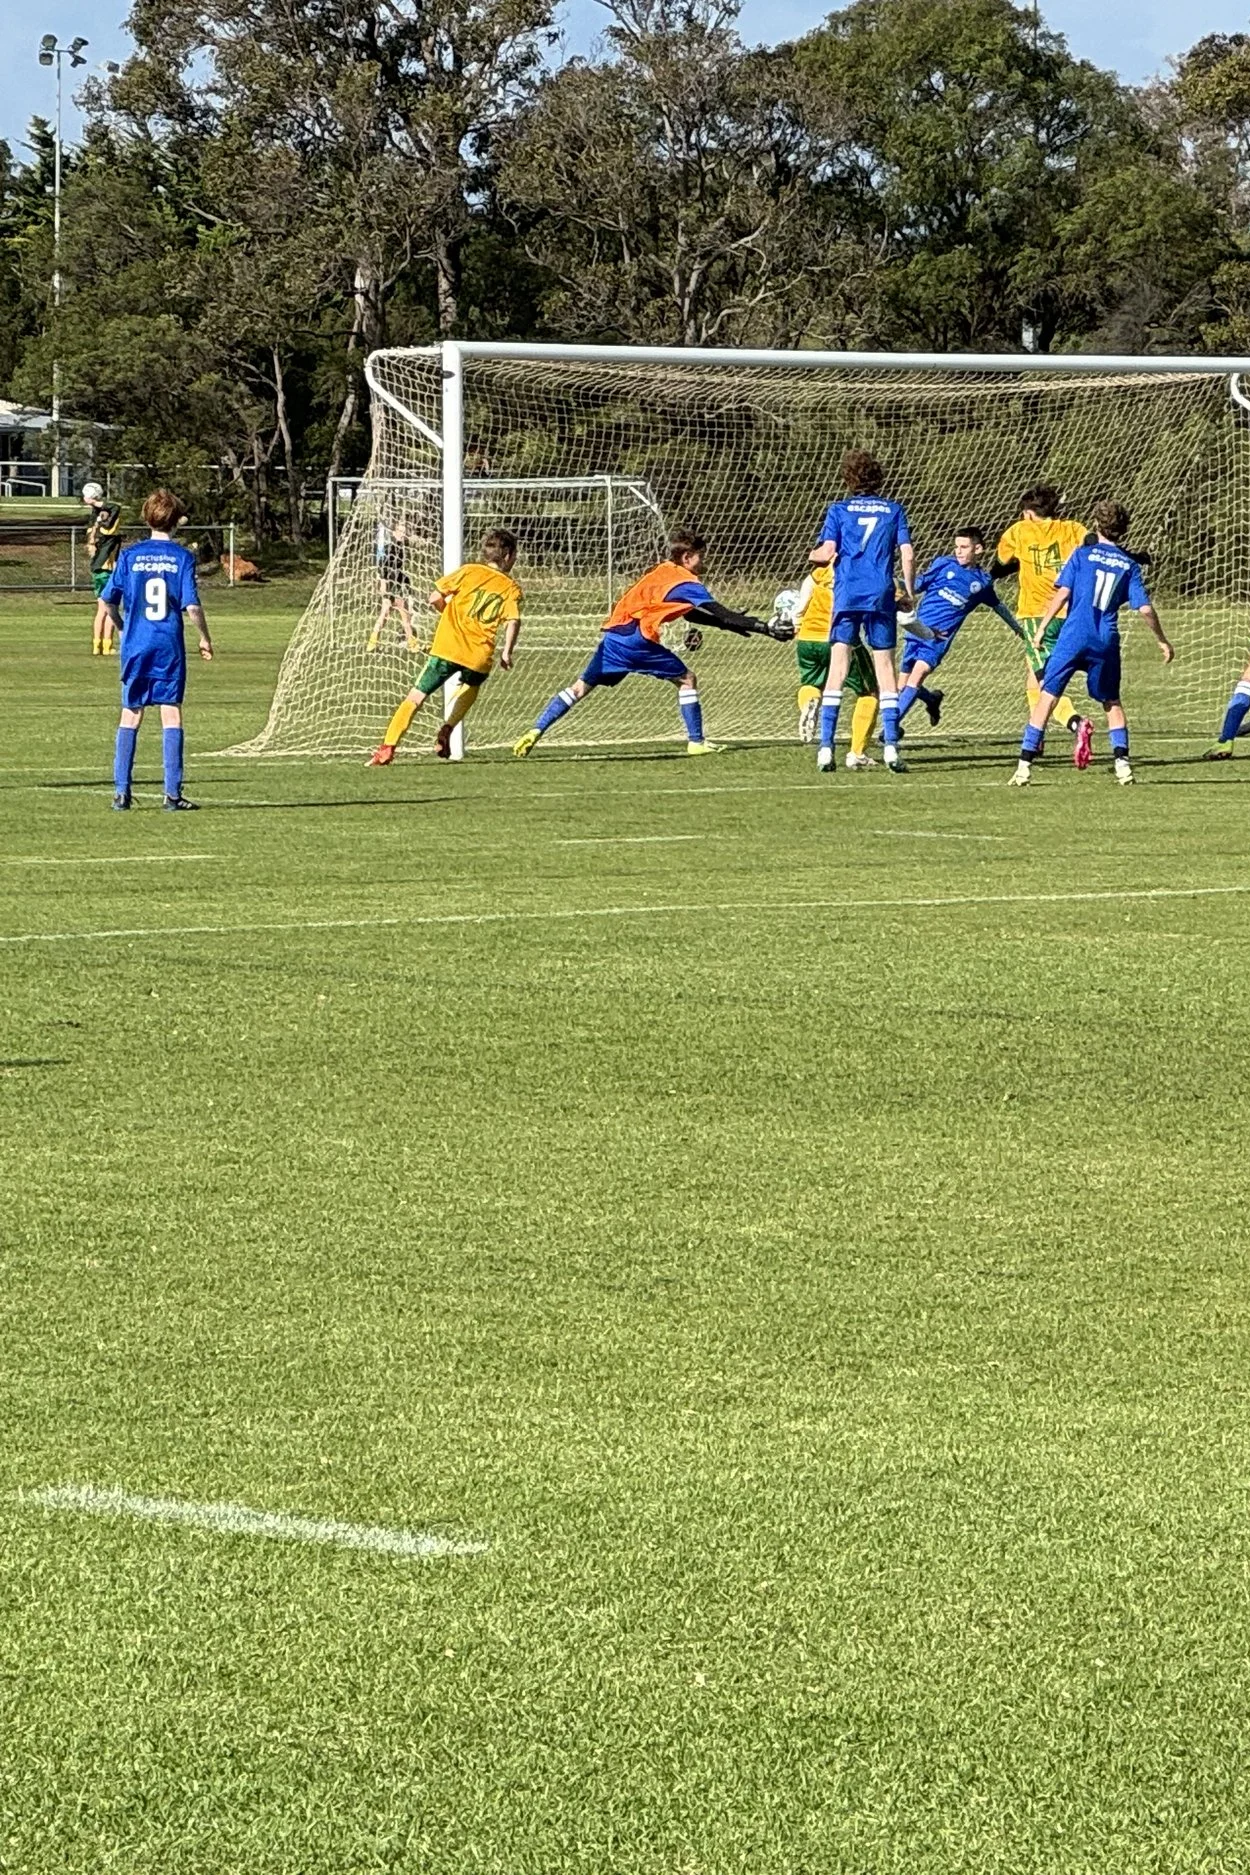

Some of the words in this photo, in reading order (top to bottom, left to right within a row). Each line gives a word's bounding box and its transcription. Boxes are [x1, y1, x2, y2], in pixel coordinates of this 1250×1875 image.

[857, 516, 878, 552] 7
[132, 561, 179, 574] escapes
[1027, 540, 1066, 576] 14
[145, 577, 167, 621] 9
[467, 588, 504, 624] 10
[1092, 568, 1117, 612] 11
